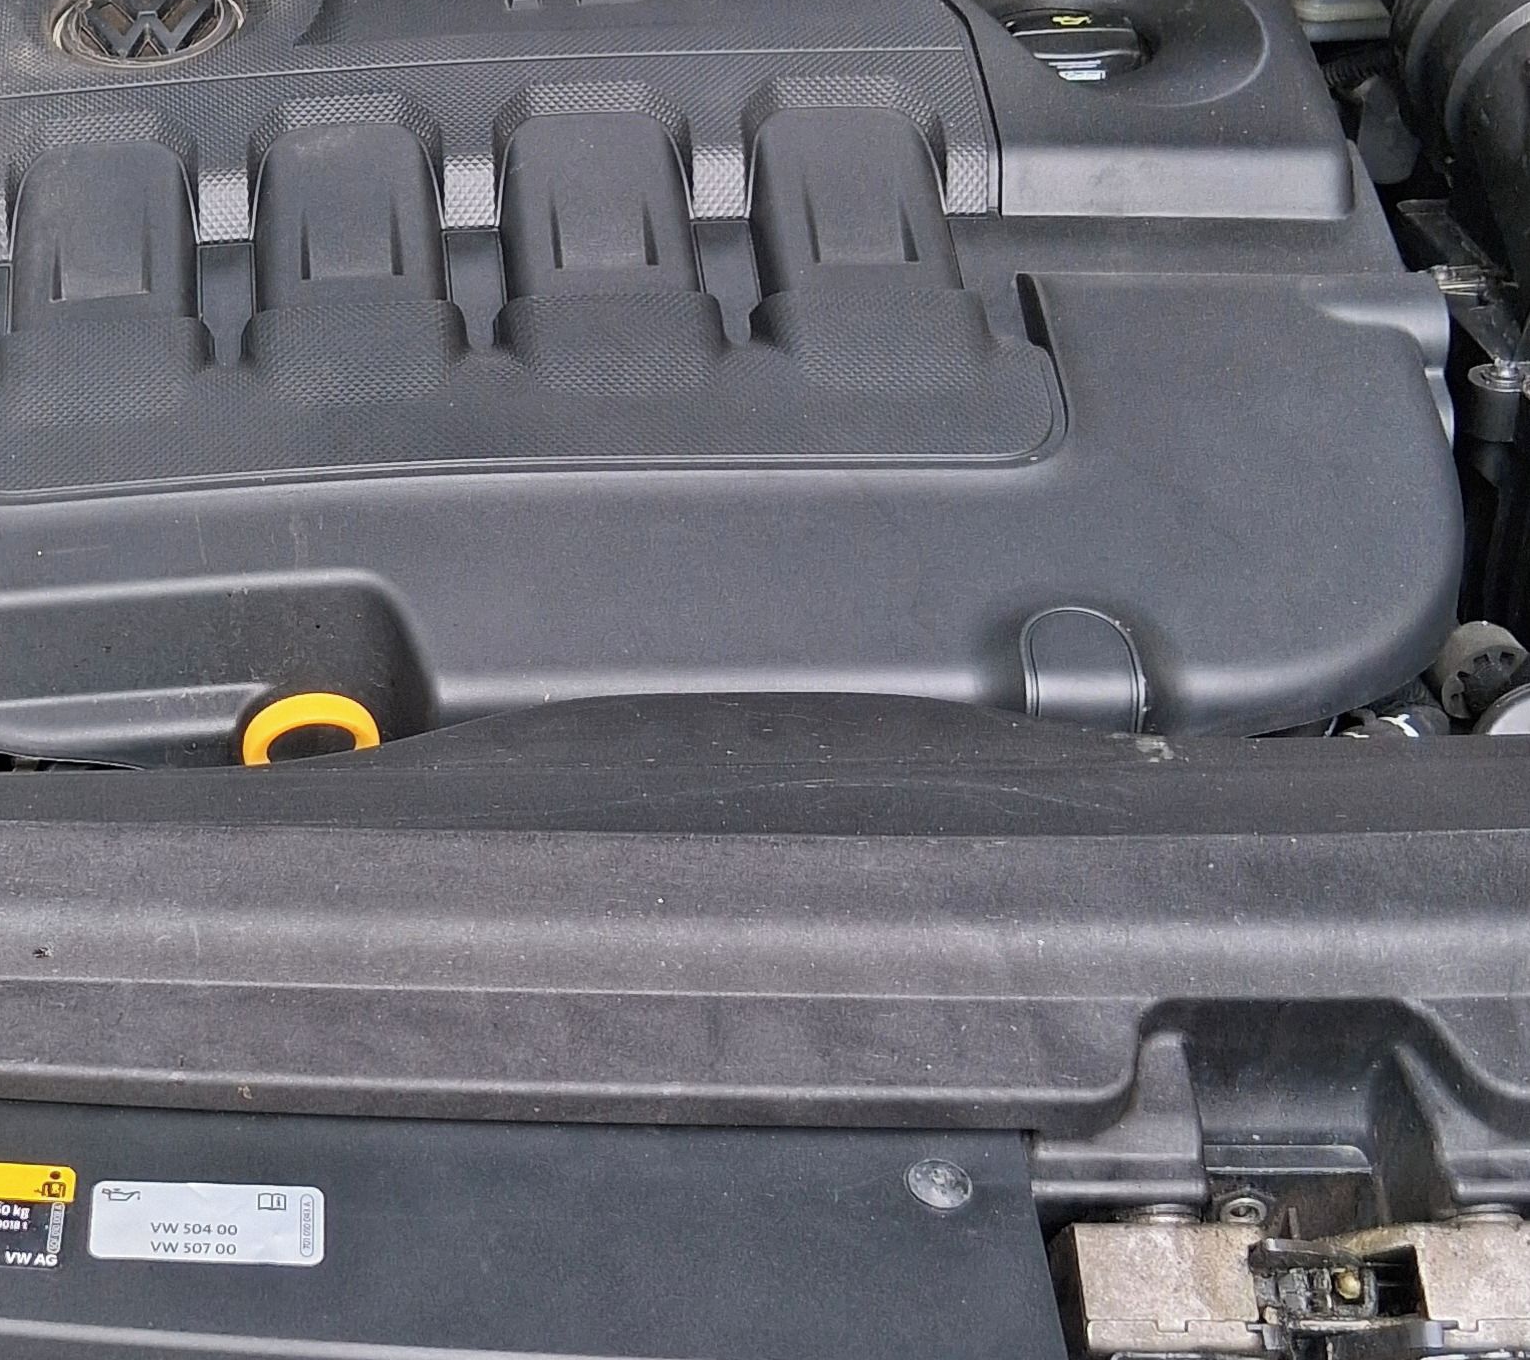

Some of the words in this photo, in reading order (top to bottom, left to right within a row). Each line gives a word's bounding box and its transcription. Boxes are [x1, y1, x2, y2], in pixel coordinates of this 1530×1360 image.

[12, 1204, 30, 1220] kg
[150, 1222, 180, 1234] VW
[183, 1223, 212, 1235] 504
[216, 1224, 238, 1236] 00
[150, 1241, 180, 1253] VW
[183, 1242, 212, 1254] 507
[215, 1243, 237, 1255] 00
[5, 1250, 32, 1265] VW
[33, 1253, 58, 1267] AG
